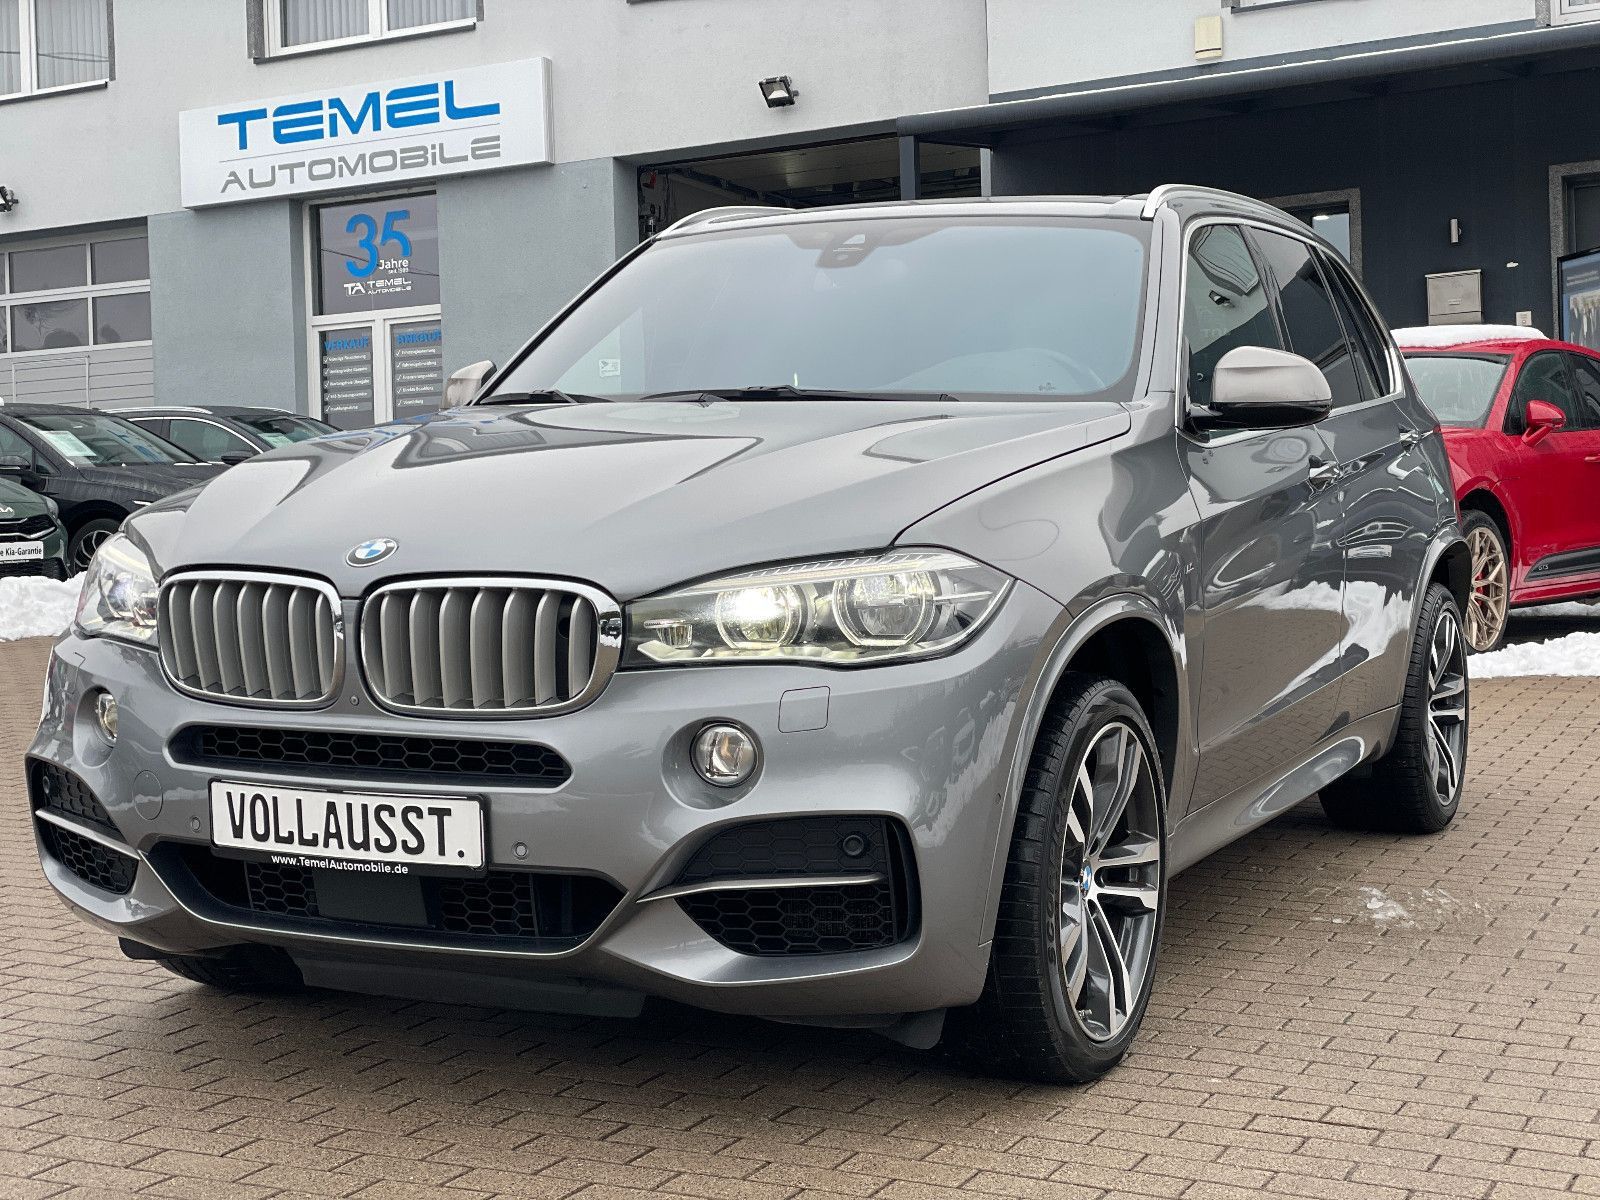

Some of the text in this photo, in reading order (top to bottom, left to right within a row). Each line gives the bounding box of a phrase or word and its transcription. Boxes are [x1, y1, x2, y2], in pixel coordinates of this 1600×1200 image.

[217, 80, 501, 150] TEMEL
[345, 210, 412, 278] 35
[379, 258, 409, 270] Jahre
[343, 282, 366, 296] TA
[366, 277, 412, 289] TEMEL
[325, 337, 369, 350] VERKAUF
[5, 546, 42, 556] Kia-Garantie
[271, 854, 409, 875] www.TemelAutomobile.de
